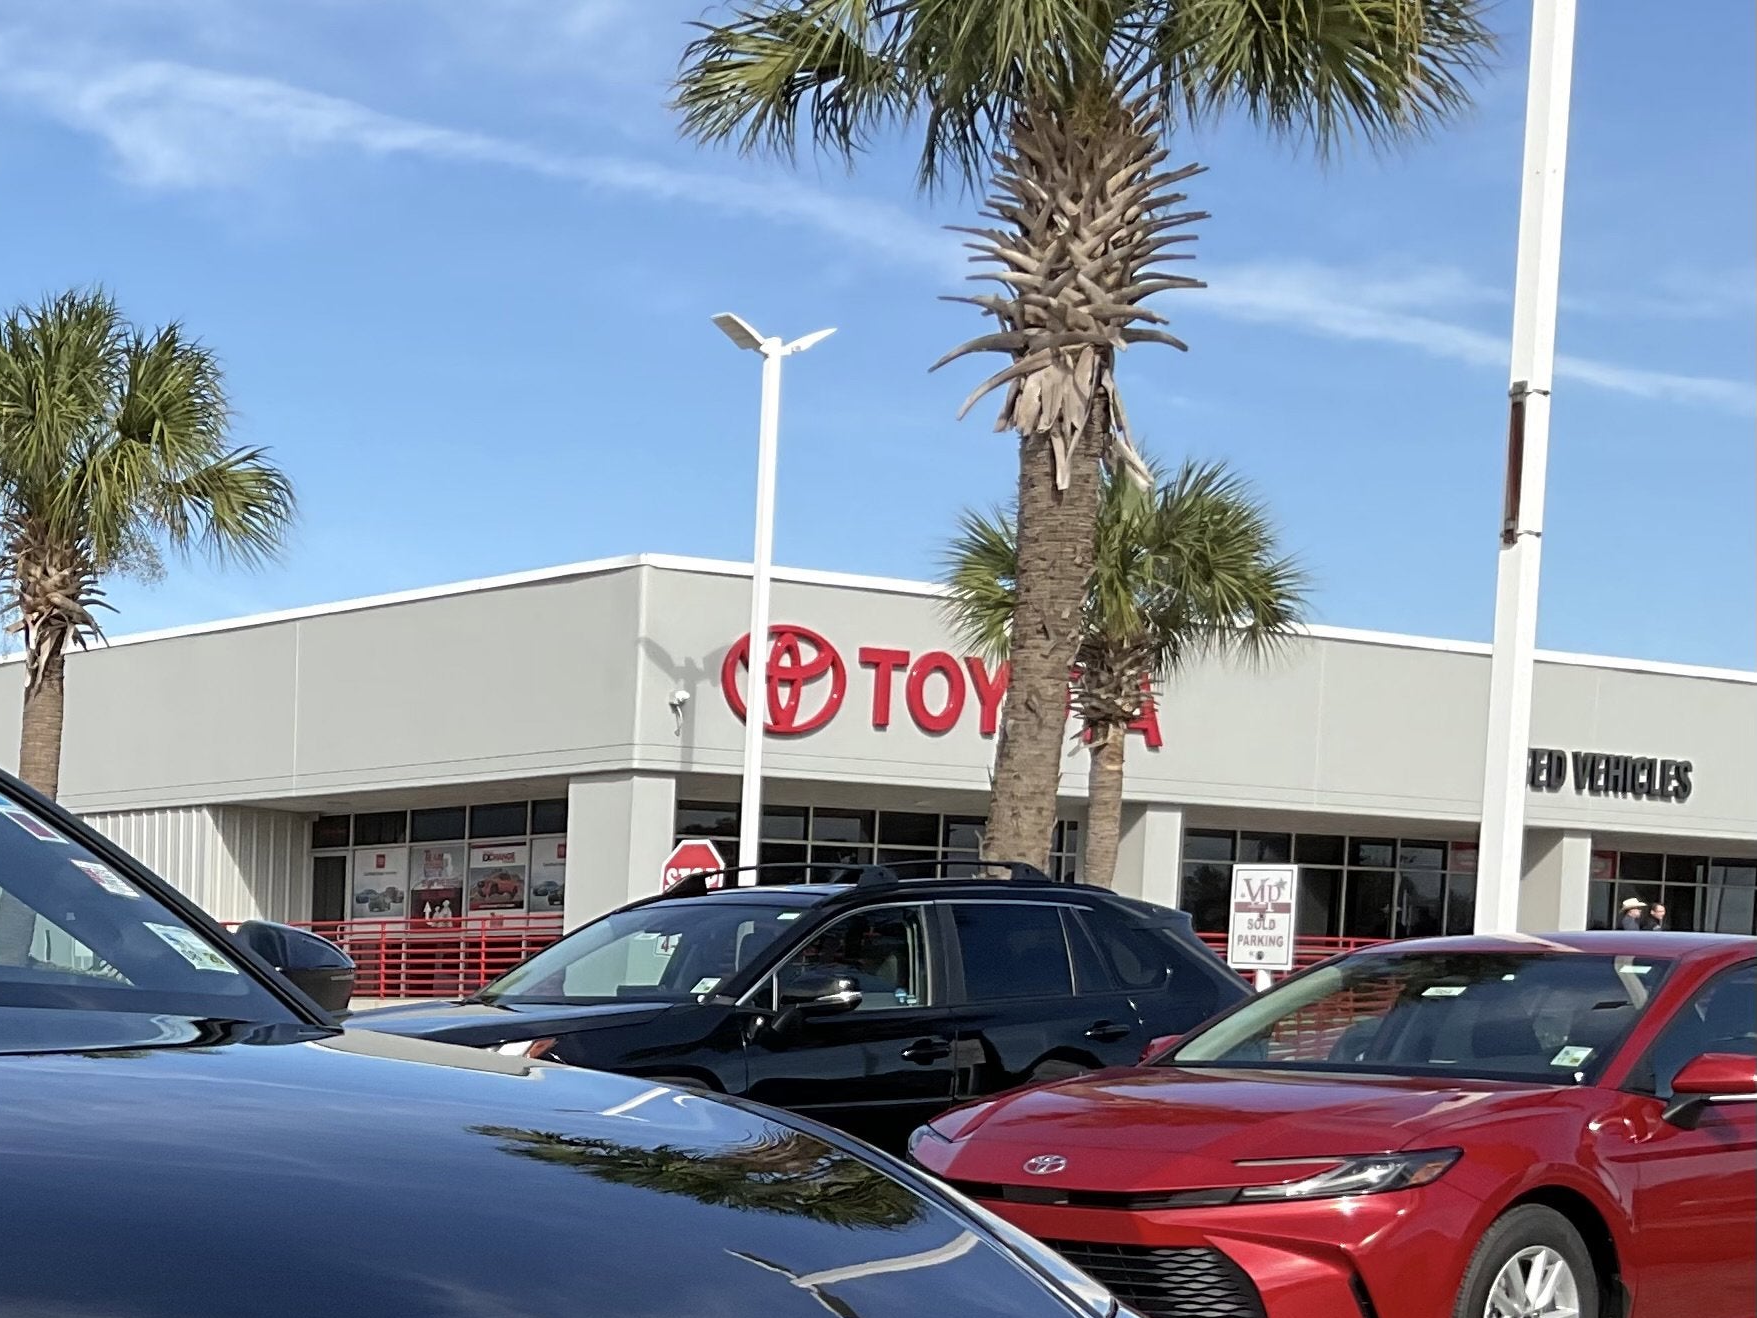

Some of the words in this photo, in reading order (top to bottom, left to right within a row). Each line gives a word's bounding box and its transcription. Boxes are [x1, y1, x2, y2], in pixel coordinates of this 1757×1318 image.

[1571, 751, 1693, 800] VEHICLES
[1247, 918, 1276, 930] SOLD
[1237, 934, 1284, 947] PARKING
